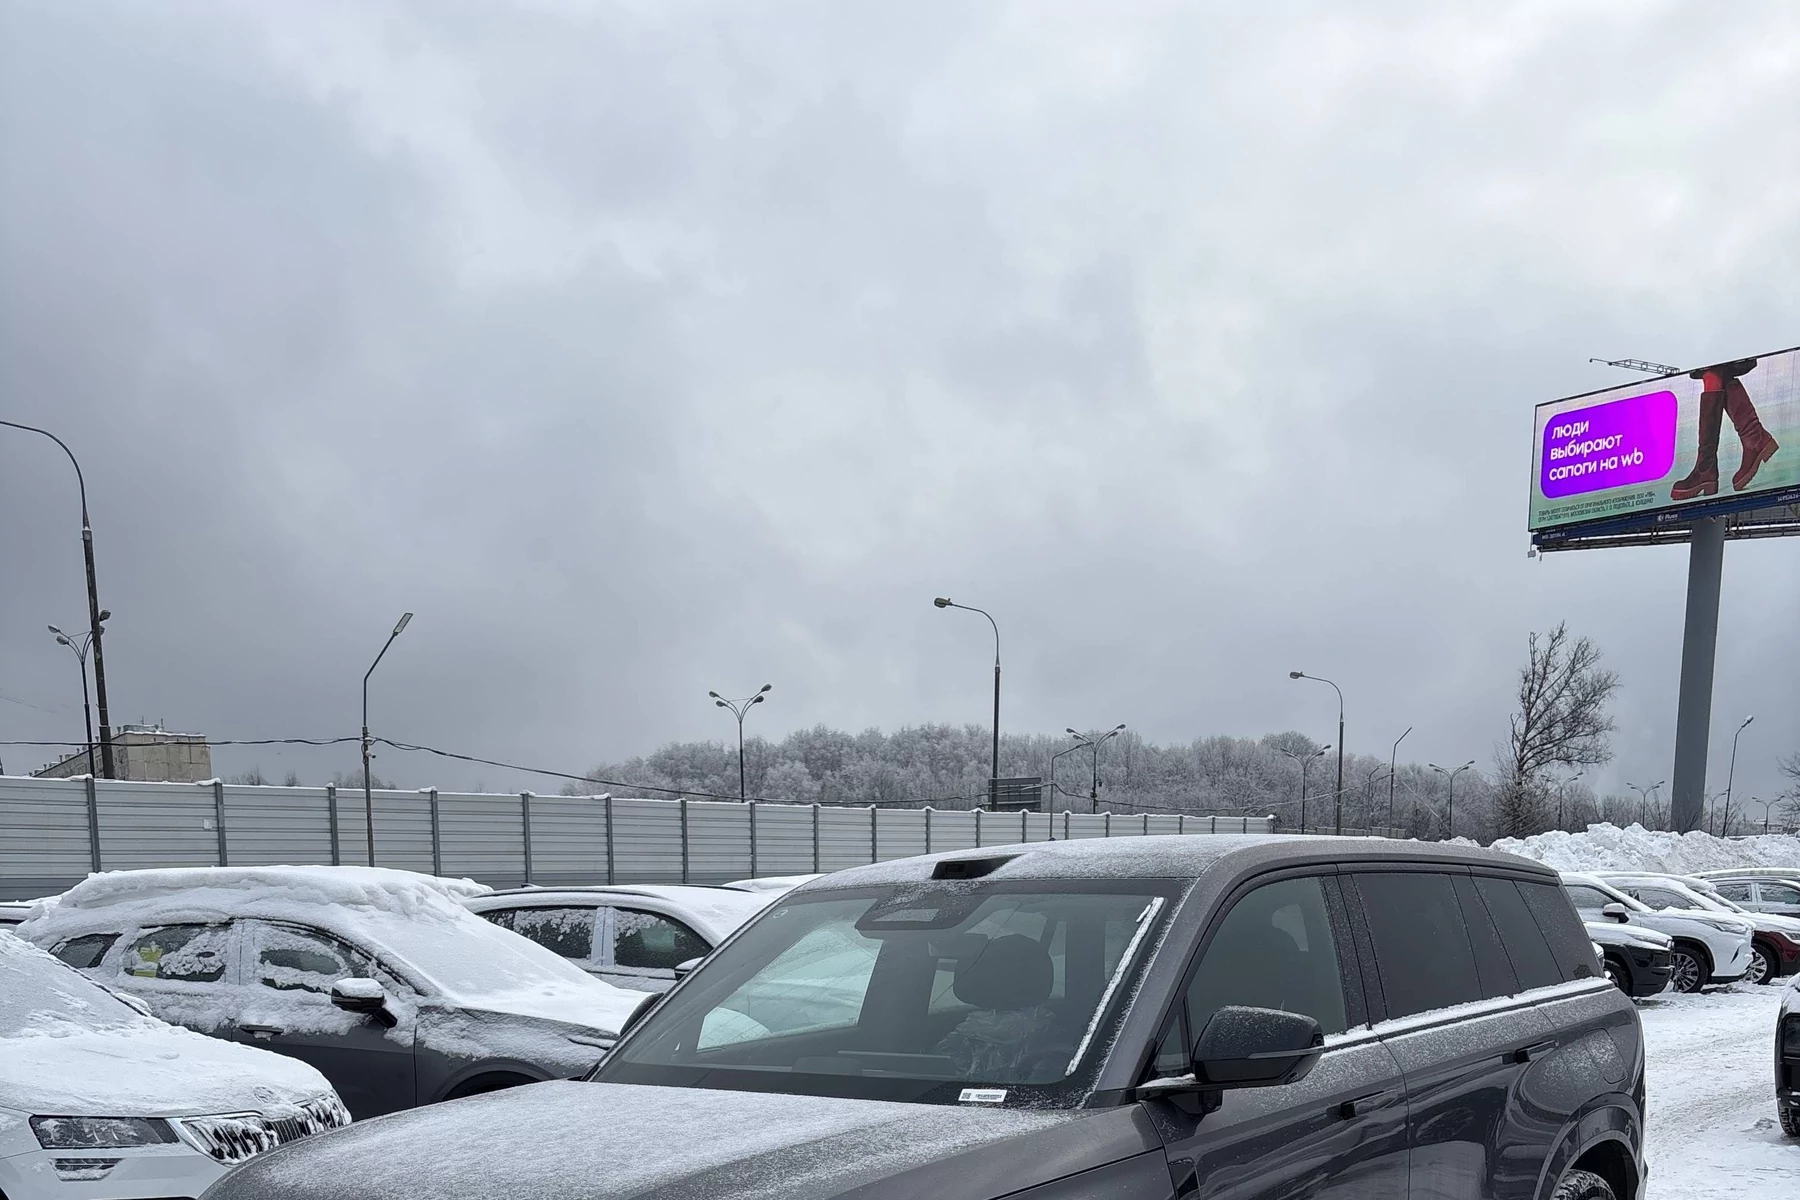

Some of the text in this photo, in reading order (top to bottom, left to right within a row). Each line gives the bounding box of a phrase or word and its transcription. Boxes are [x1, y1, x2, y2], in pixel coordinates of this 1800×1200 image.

[1551, 420, 1589, 439] люди
[1550, 434, 1623, 460] выбирают
[1549, 447, 1644, 481] сапоги на wb
